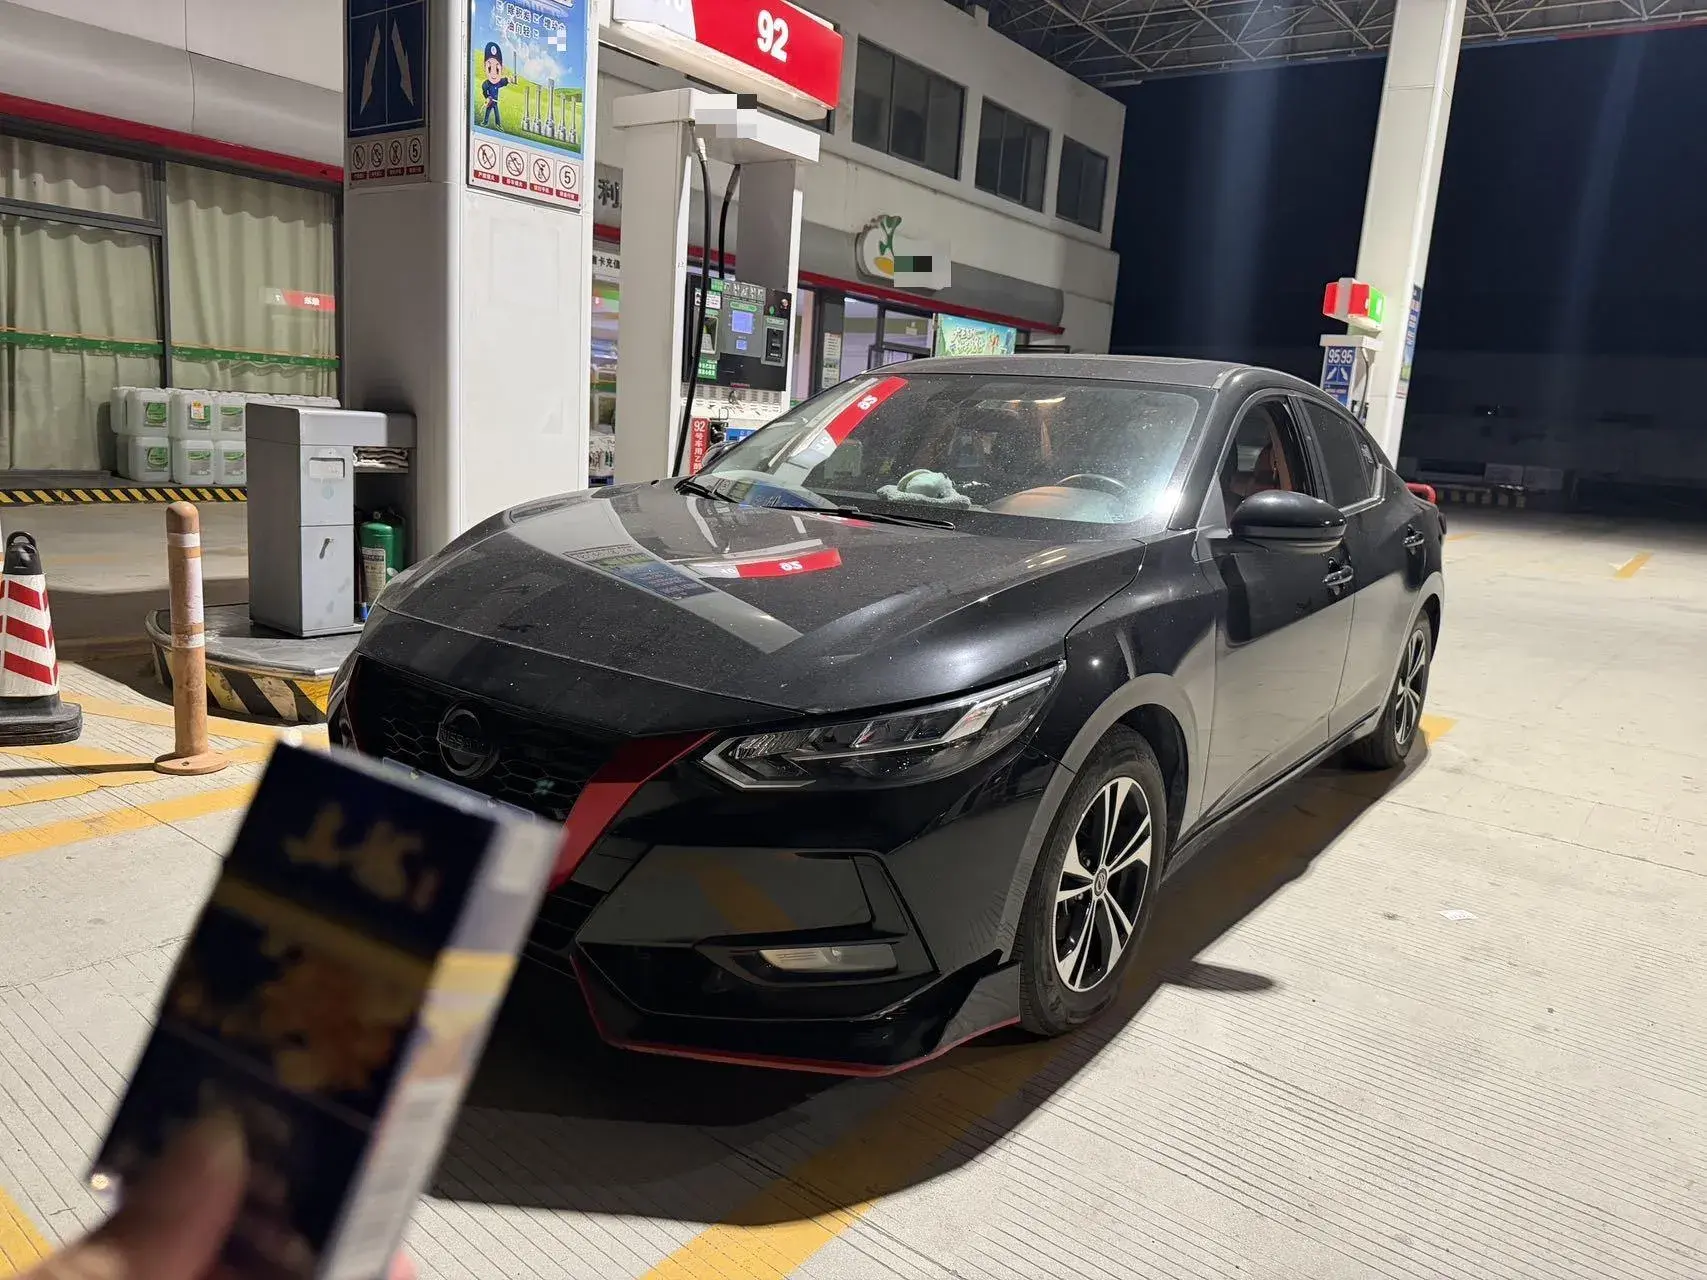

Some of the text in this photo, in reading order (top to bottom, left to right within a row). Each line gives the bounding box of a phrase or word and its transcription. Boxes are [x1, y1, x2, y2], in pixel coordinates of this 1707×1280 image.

[757, 9, 789, 63] 92
[564, 171, 571, 185] 5
[598, 179, 620, 208] 利
[1328, 349, 1353, 364] 95 95
